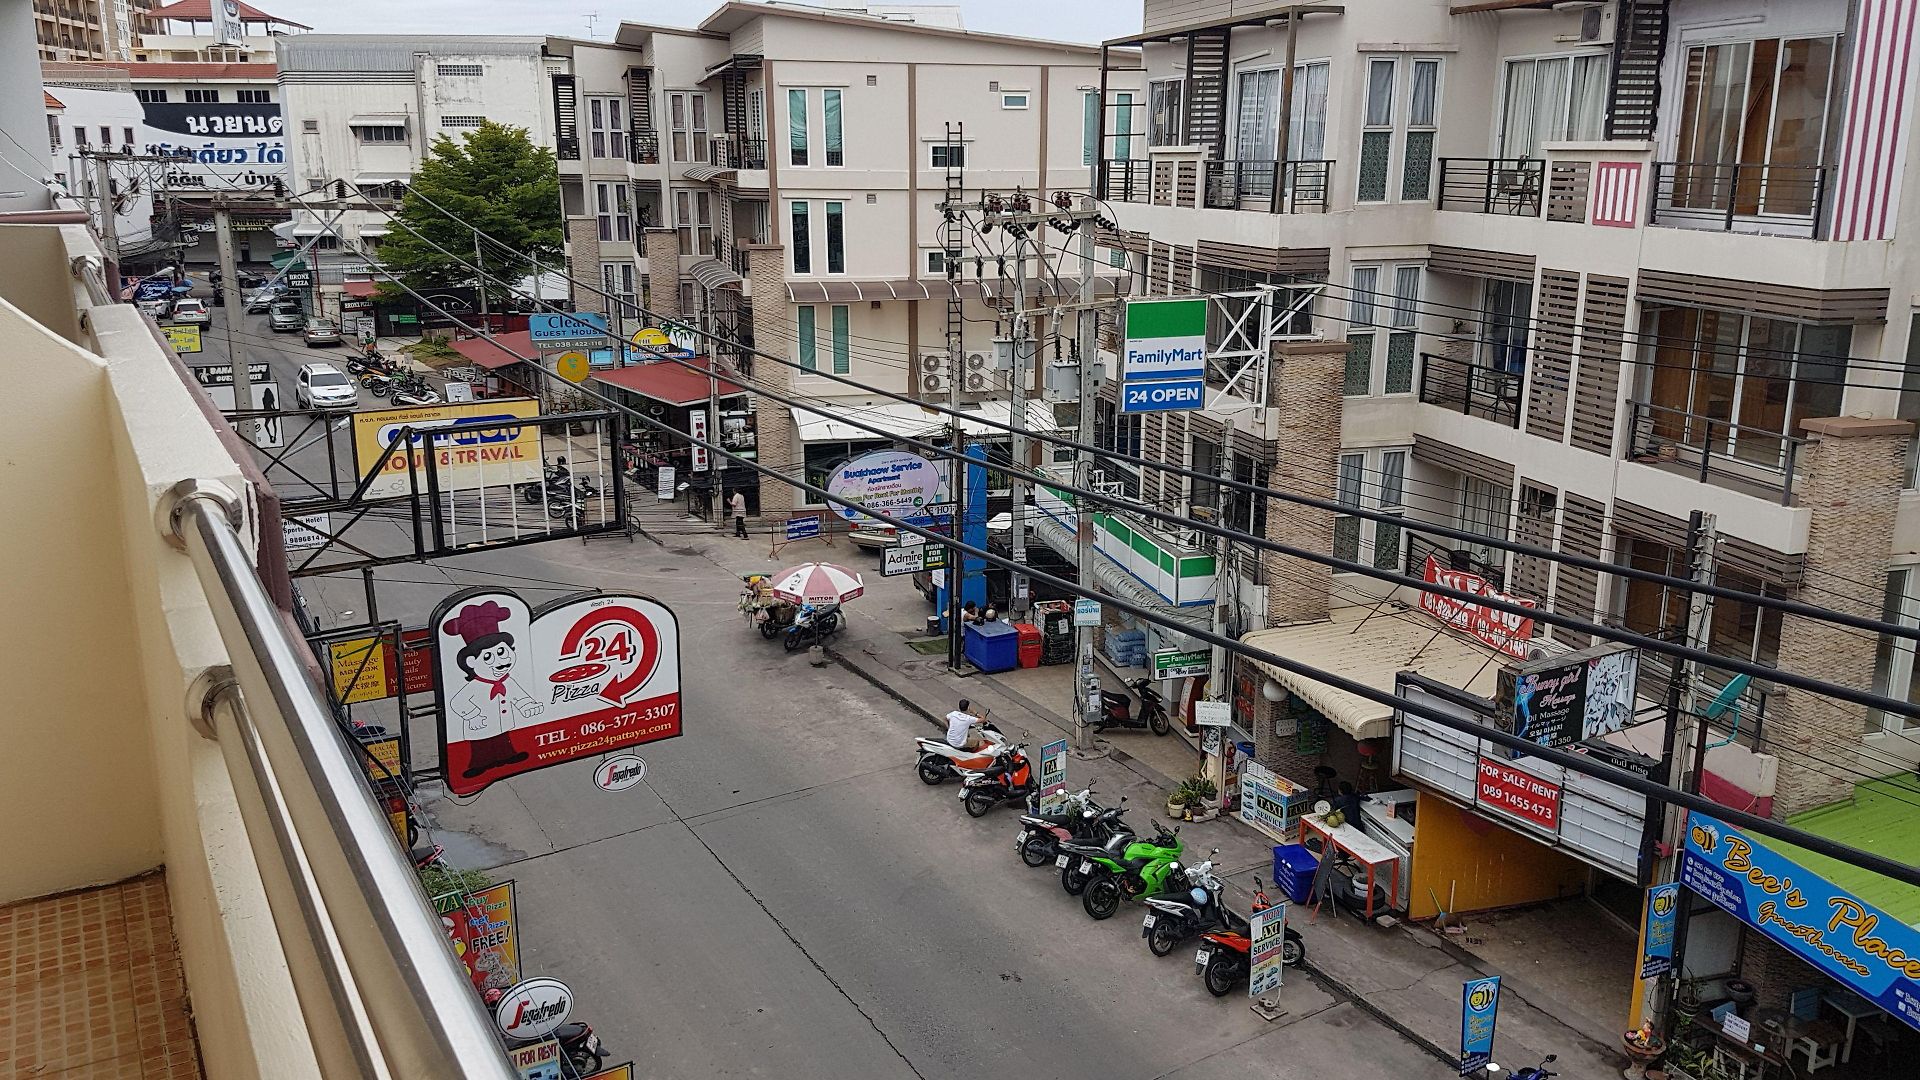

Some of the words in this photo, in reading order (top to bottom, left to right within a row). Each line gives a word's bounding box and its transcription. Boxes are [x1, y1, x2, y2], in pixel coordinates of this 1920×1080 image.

[548, 316, 591, 328] Clean
[534, 329, 567, 337] GUEST
[1128, 348, 1202, 365] FamilyMart
[1129, 390, 1147, 404] 24
[1151, 387, 1199, 402] OPEN
[456, 446, 524, 464] TRAVAL
[891, 462, 923, 473] Service
[887, 550, 923, 565] Admire
[584, 630, 634, 664] 24
[338, 657, 379, 668] Massge
[1171, 653, 1206, 662] FamilyMart
[551, 681, 600, 704] Pizza
[1527, 714, 1537, 723] Oil
[1539, 707, 1570, 719] Massage
[535, 730, 570, 747] TEL
[580, 703, 676, 736] 086-377-3307
[537, 721, 672, 760] www.pizza24pattaya.com
[1480, 763, 1499, 779] FOR
[1502, 769, 1526, 788] SALE
[1532, 782, 1558, 801] RENT
[1258, 797, 1282, 817] TAXI
[1483, 782, 1502, 799] 089
[1504, 791, 1530, 811] 1455
[1531, 801, 1552, 819] 473
[1256, 810, 1283, 828] SERVICE
[485, 900, 507, 912] Pizza
[1723, 835, 1807, 909] Bee's
[1828, 896, 1920, 979] Place
[472, 926, 511, 953] FREE!
[1253, 937, 1281, 956] SERVICE
[1758, 901, 1871, 977] Guesthouse
[506, 996, 567, 1030] Segafredo
[520, 1050, 536, 1066] FOR
[537, 1043, 558, 1060] RENT
